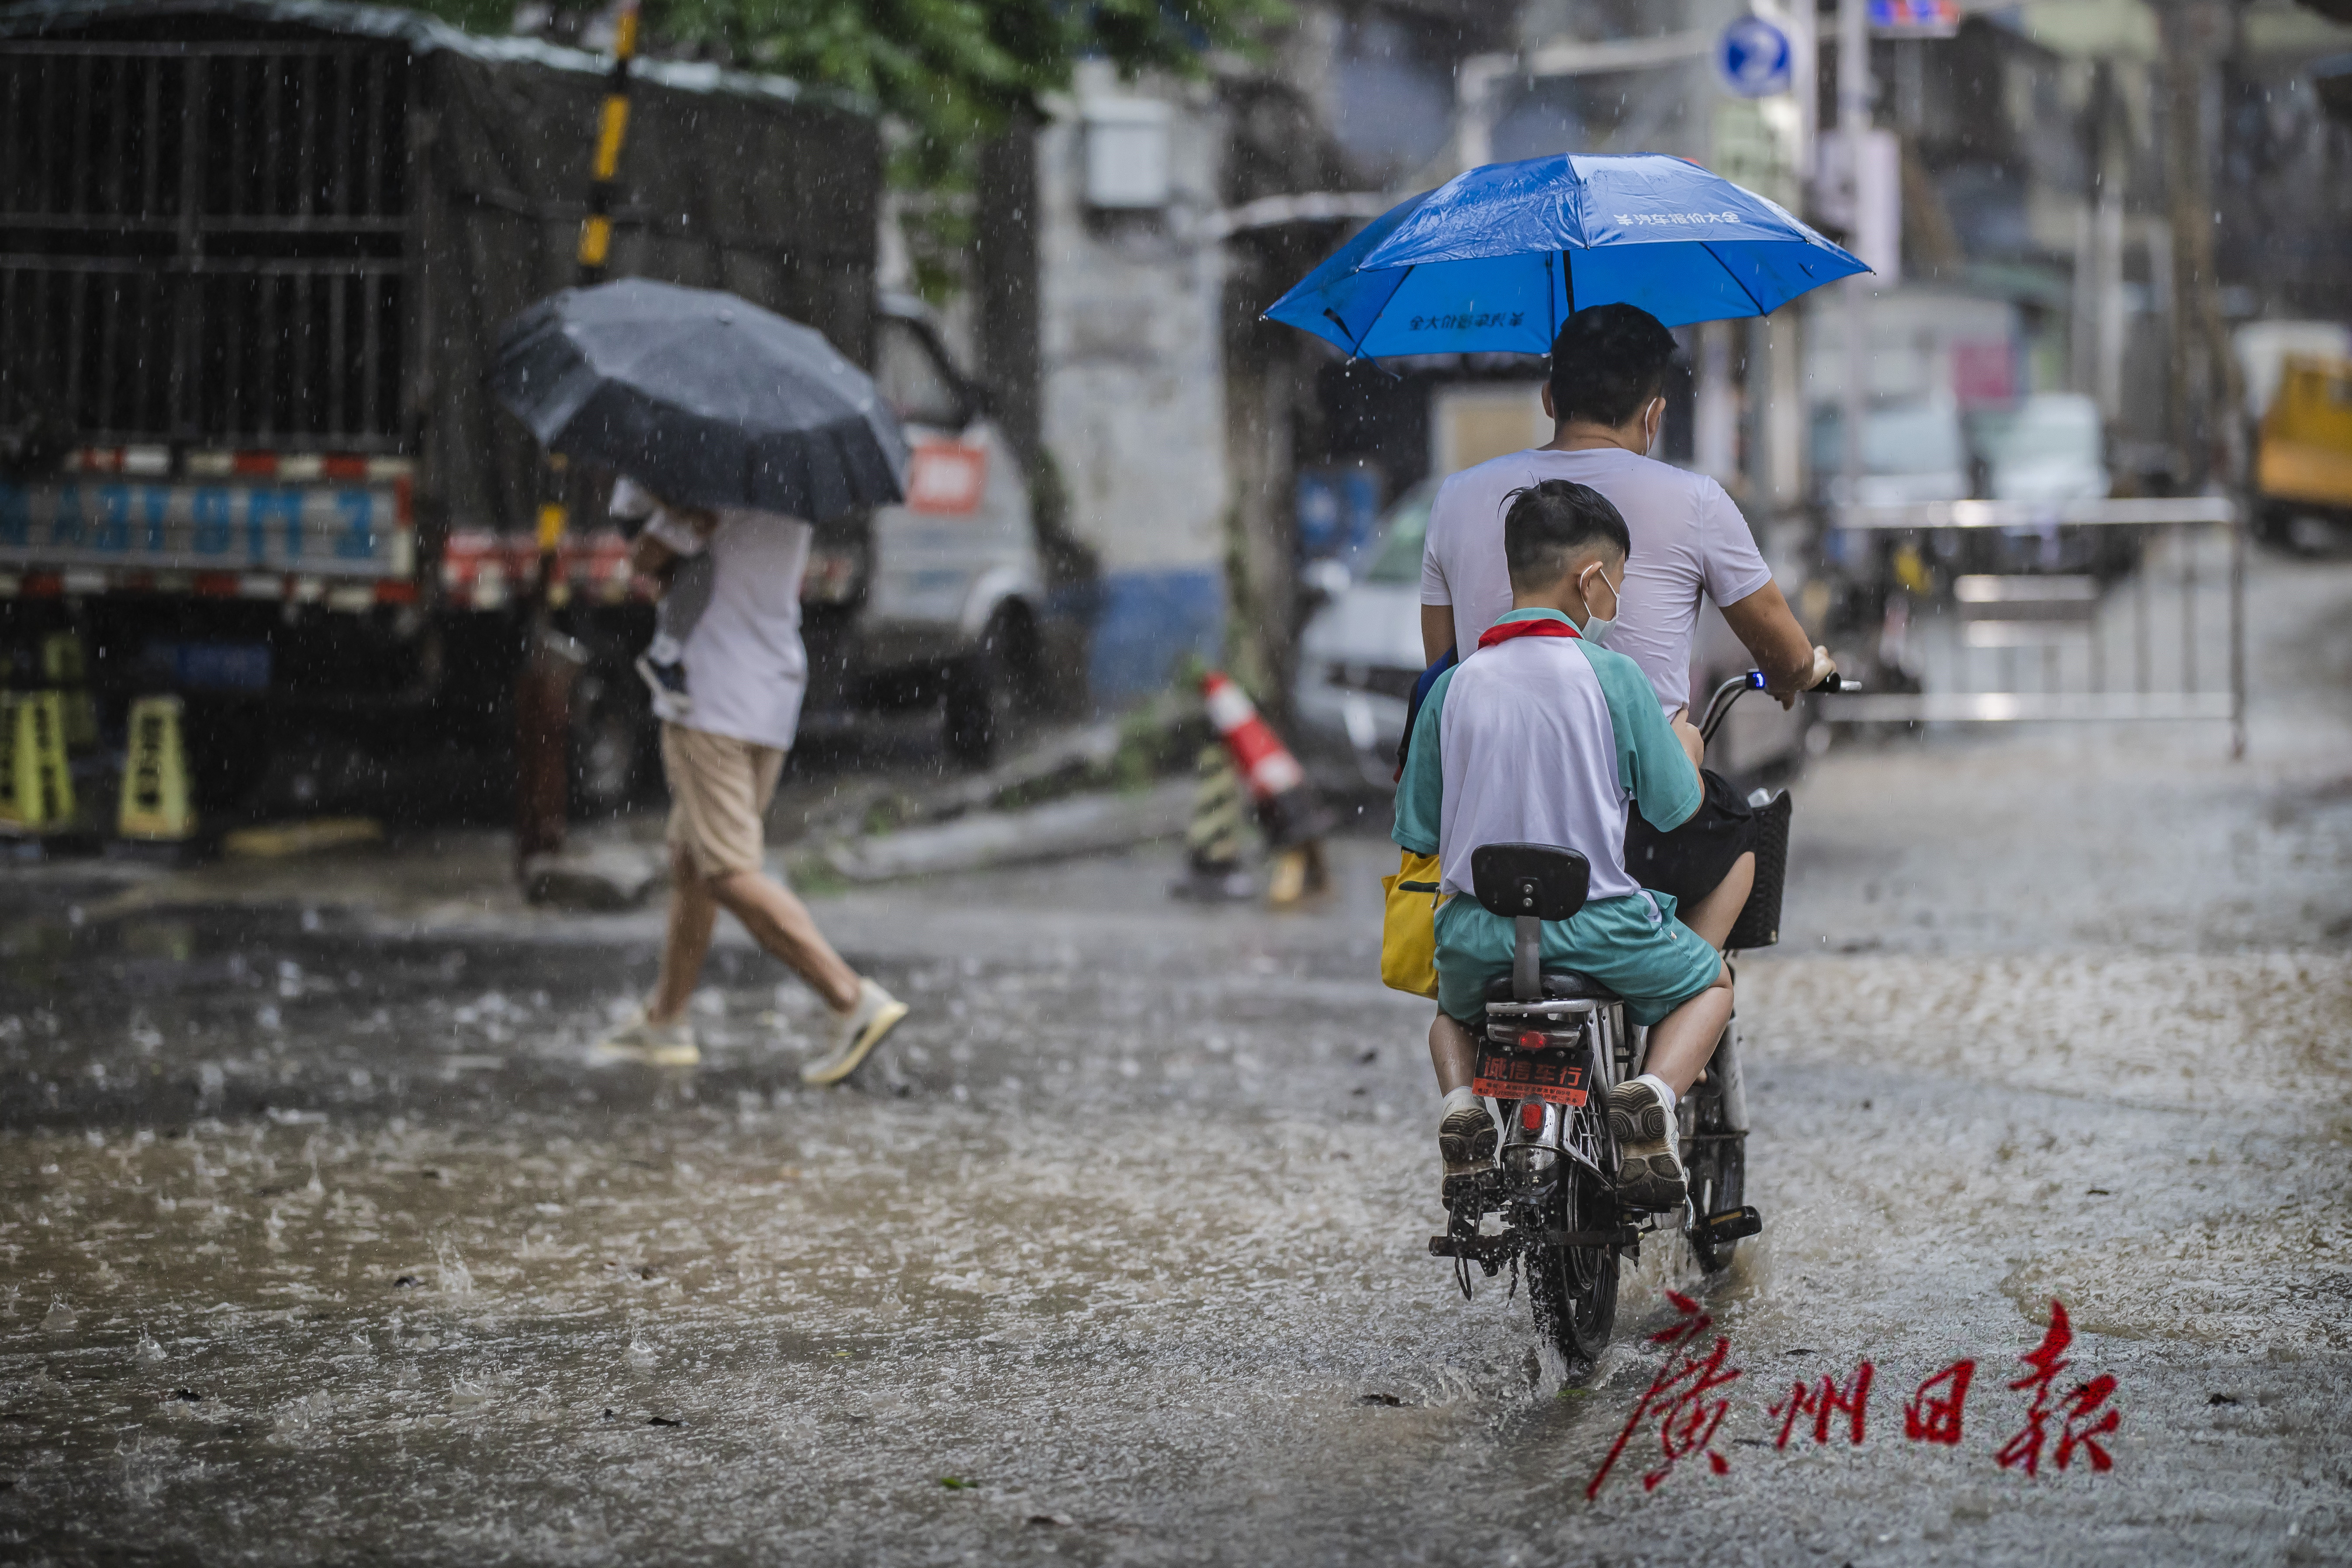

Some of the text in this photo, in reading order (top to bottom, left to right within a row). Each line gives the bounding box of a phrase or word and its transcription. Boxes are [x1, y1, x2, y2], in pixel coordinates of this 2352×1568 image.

[1633, 211, 1741, 225] 汽车报价大全
[1484, 1056, 1582, 1086] 诚信车行
